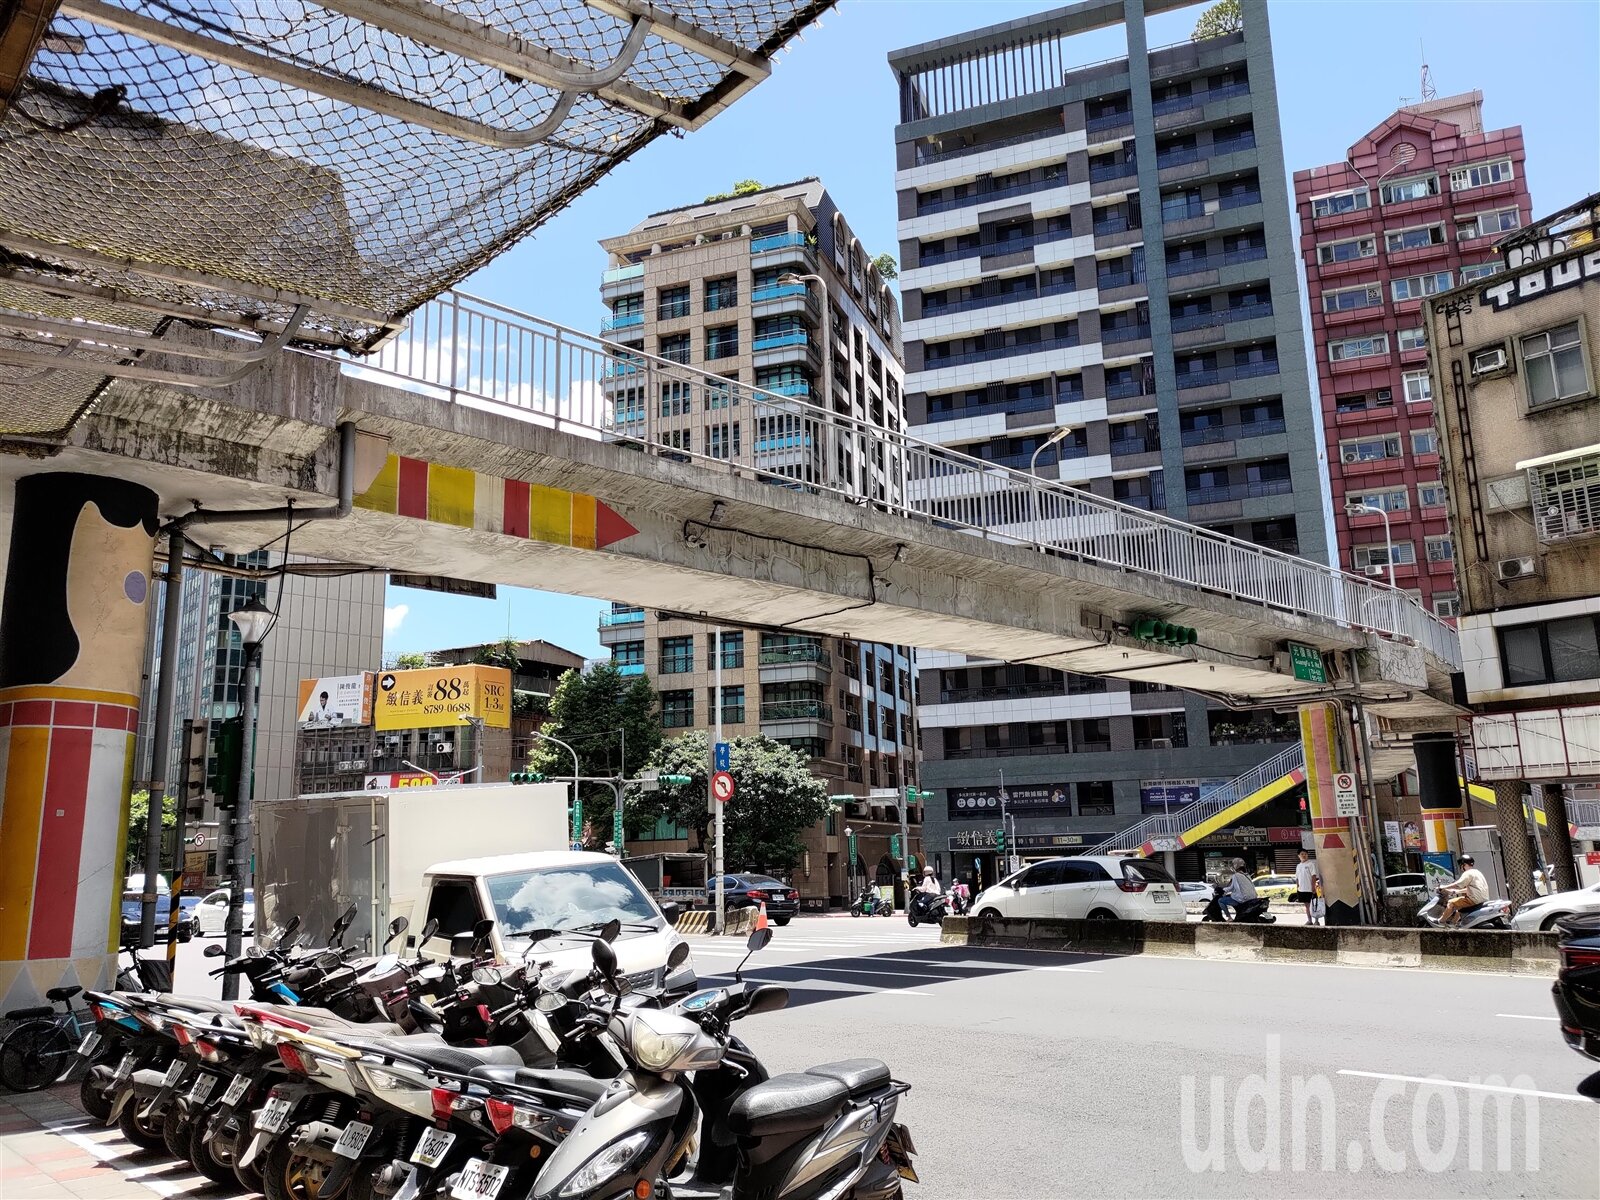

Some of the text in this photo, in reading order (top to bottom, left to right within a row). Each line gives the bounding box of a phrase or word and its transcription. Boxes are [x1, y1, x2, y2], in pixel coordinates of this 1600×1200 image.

[434, 677, 461, 701] 88
[484, 684, 505, 697] SRC
[423, 702, 471, 714] 8789-0688
[456, 1168, 502, 1198] NTS-3502
